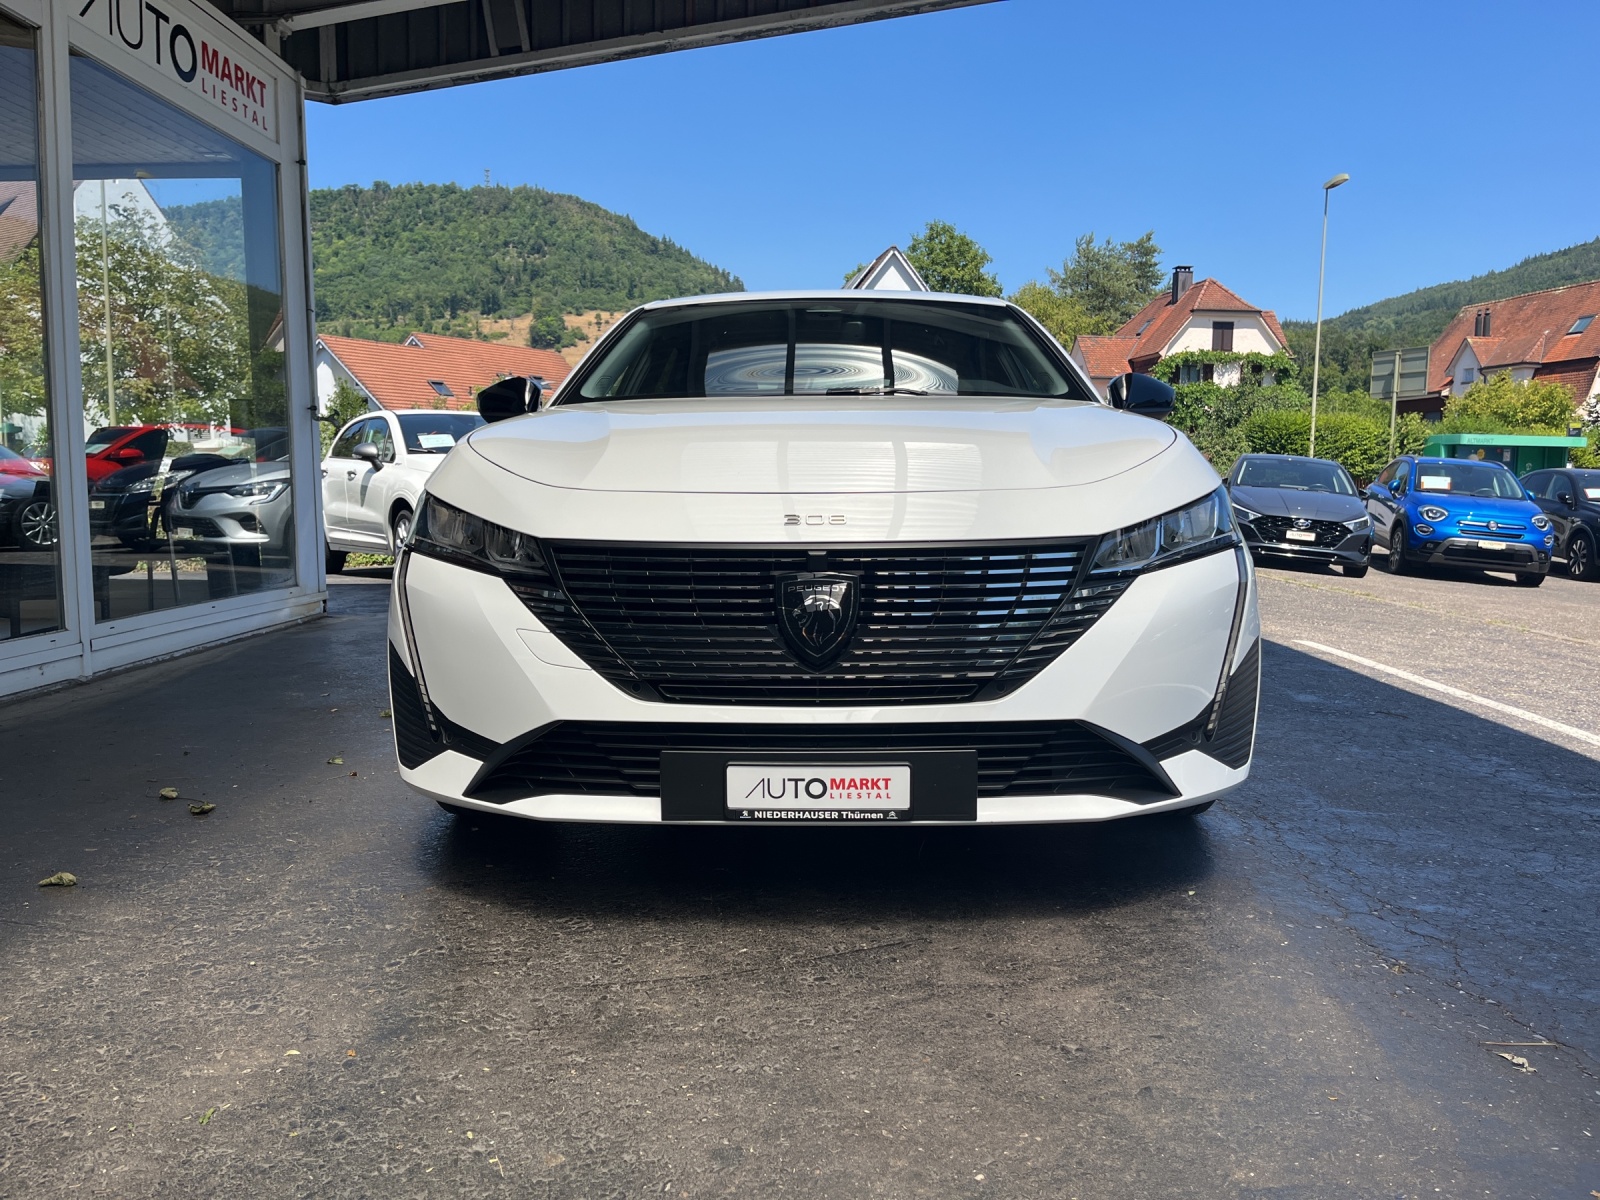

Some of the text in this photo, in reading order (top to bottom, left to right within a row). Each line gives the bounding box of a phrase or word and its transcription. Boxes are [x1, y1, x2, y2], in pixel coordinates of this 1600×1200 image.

[201, 41, 266, 108] MARKT
[202, 78, 268, 131] LIESTAL
[784, 514, 846, 526] 308
[788, 584, 847, 592] PEUGEOT
[745, 777, 892, 799] AUTO MARKT
[754, 811, 884, 819] NIEDERHAUSER Thürnen
